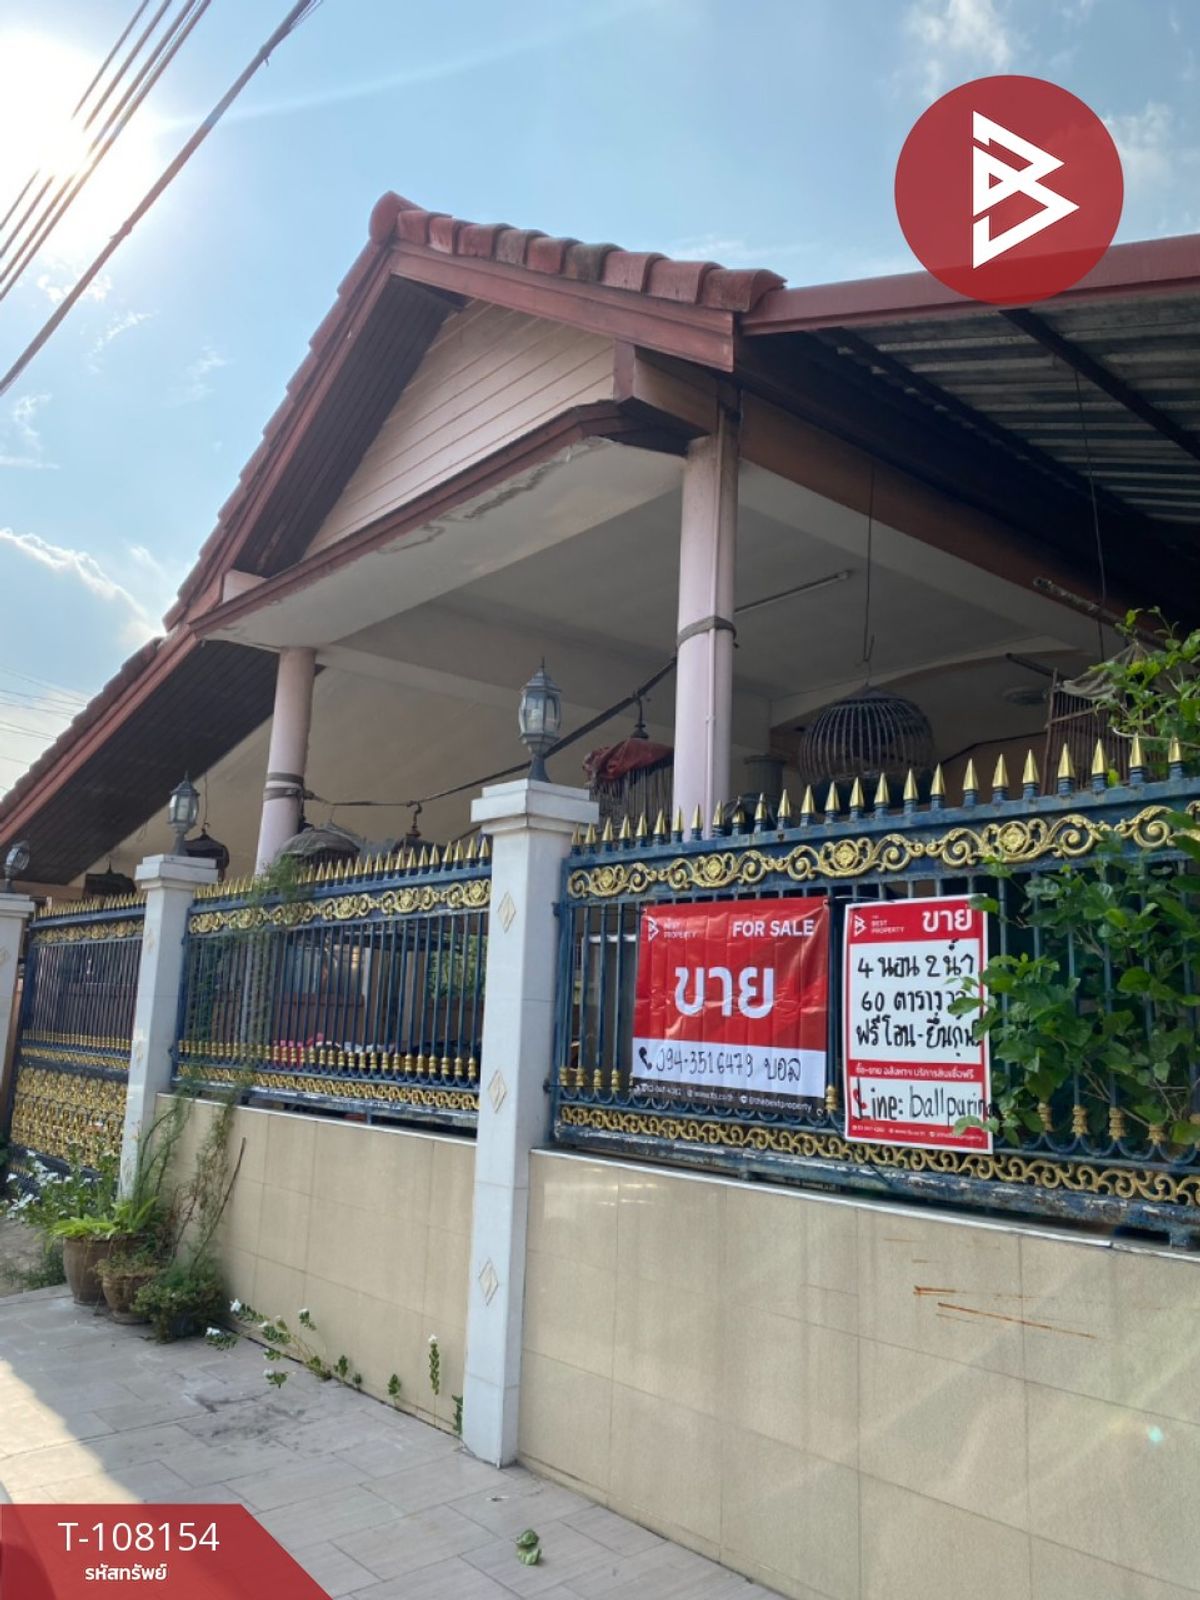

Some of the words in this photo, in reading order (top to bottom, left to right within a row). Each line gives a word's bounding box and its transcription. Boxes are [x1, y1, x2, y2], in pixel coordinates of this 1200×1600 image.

[732, 921, 764, 938] FOR
[769, 919, 815, 937] SALE
[922, 909, 973, 933] ขาย
[857, 957, 874, 979] 4
[877, 955, 920, 978] นอน
[925, 954, 940, 978] 2
[674, 966, 774, 1019] ขาย
[861, 990, 885, 1012] 60
